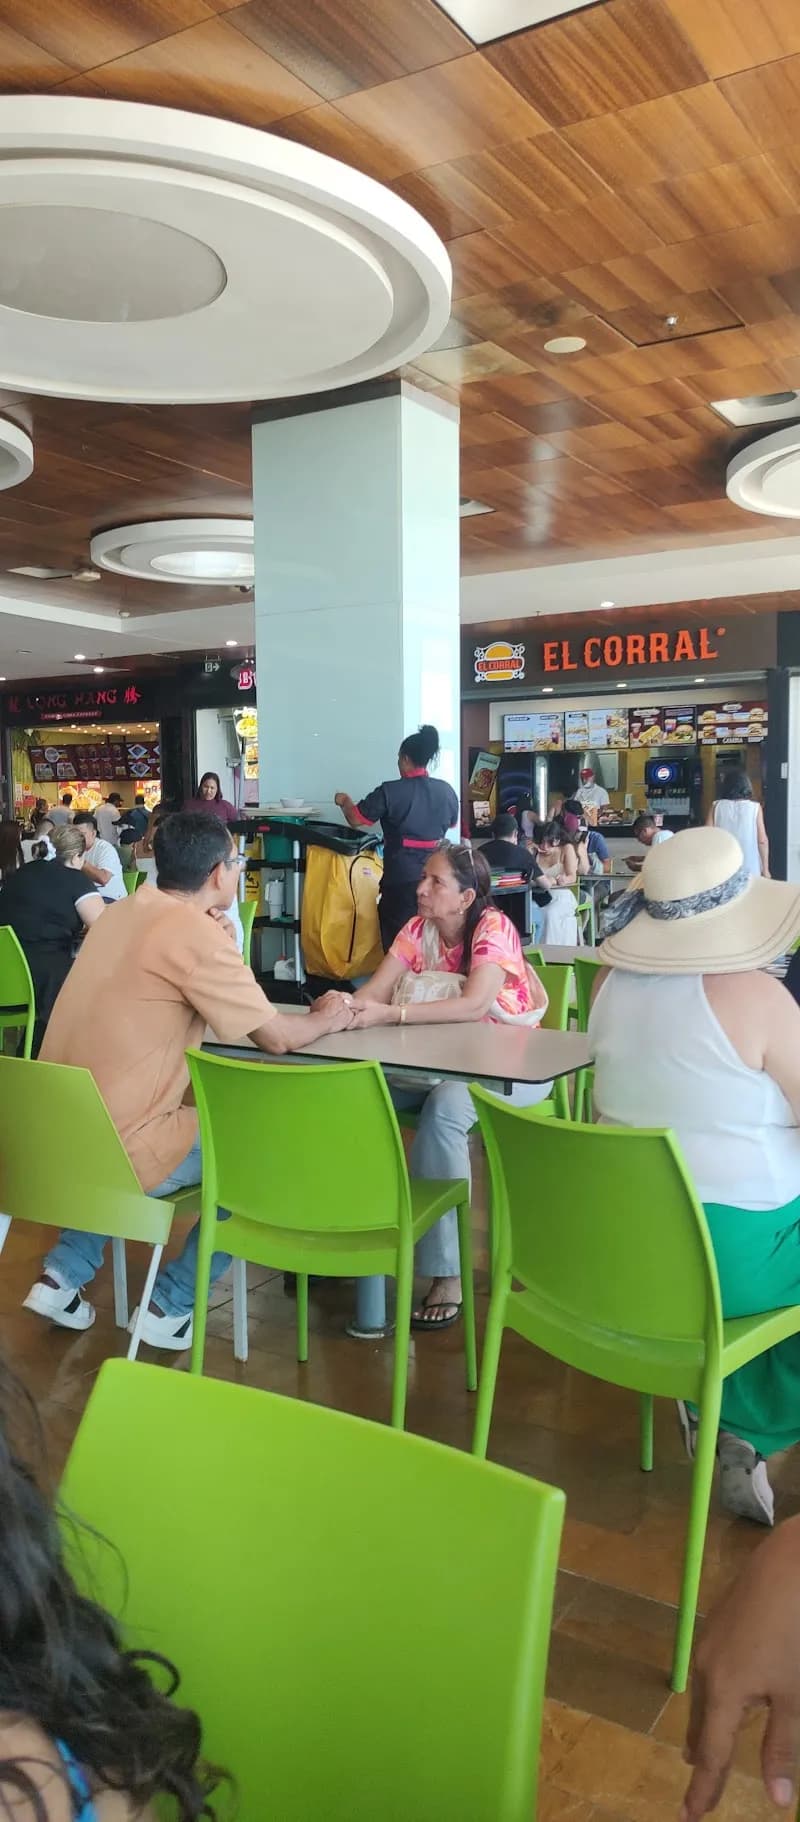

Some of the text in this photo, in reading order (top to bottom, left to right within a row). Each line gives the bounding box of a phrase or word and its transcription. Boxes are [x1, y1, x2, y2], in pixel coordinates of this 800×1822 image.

[543, 627, 719, 672] EL CORRAL
[478, 659, 520, 671] EL CORRAL
